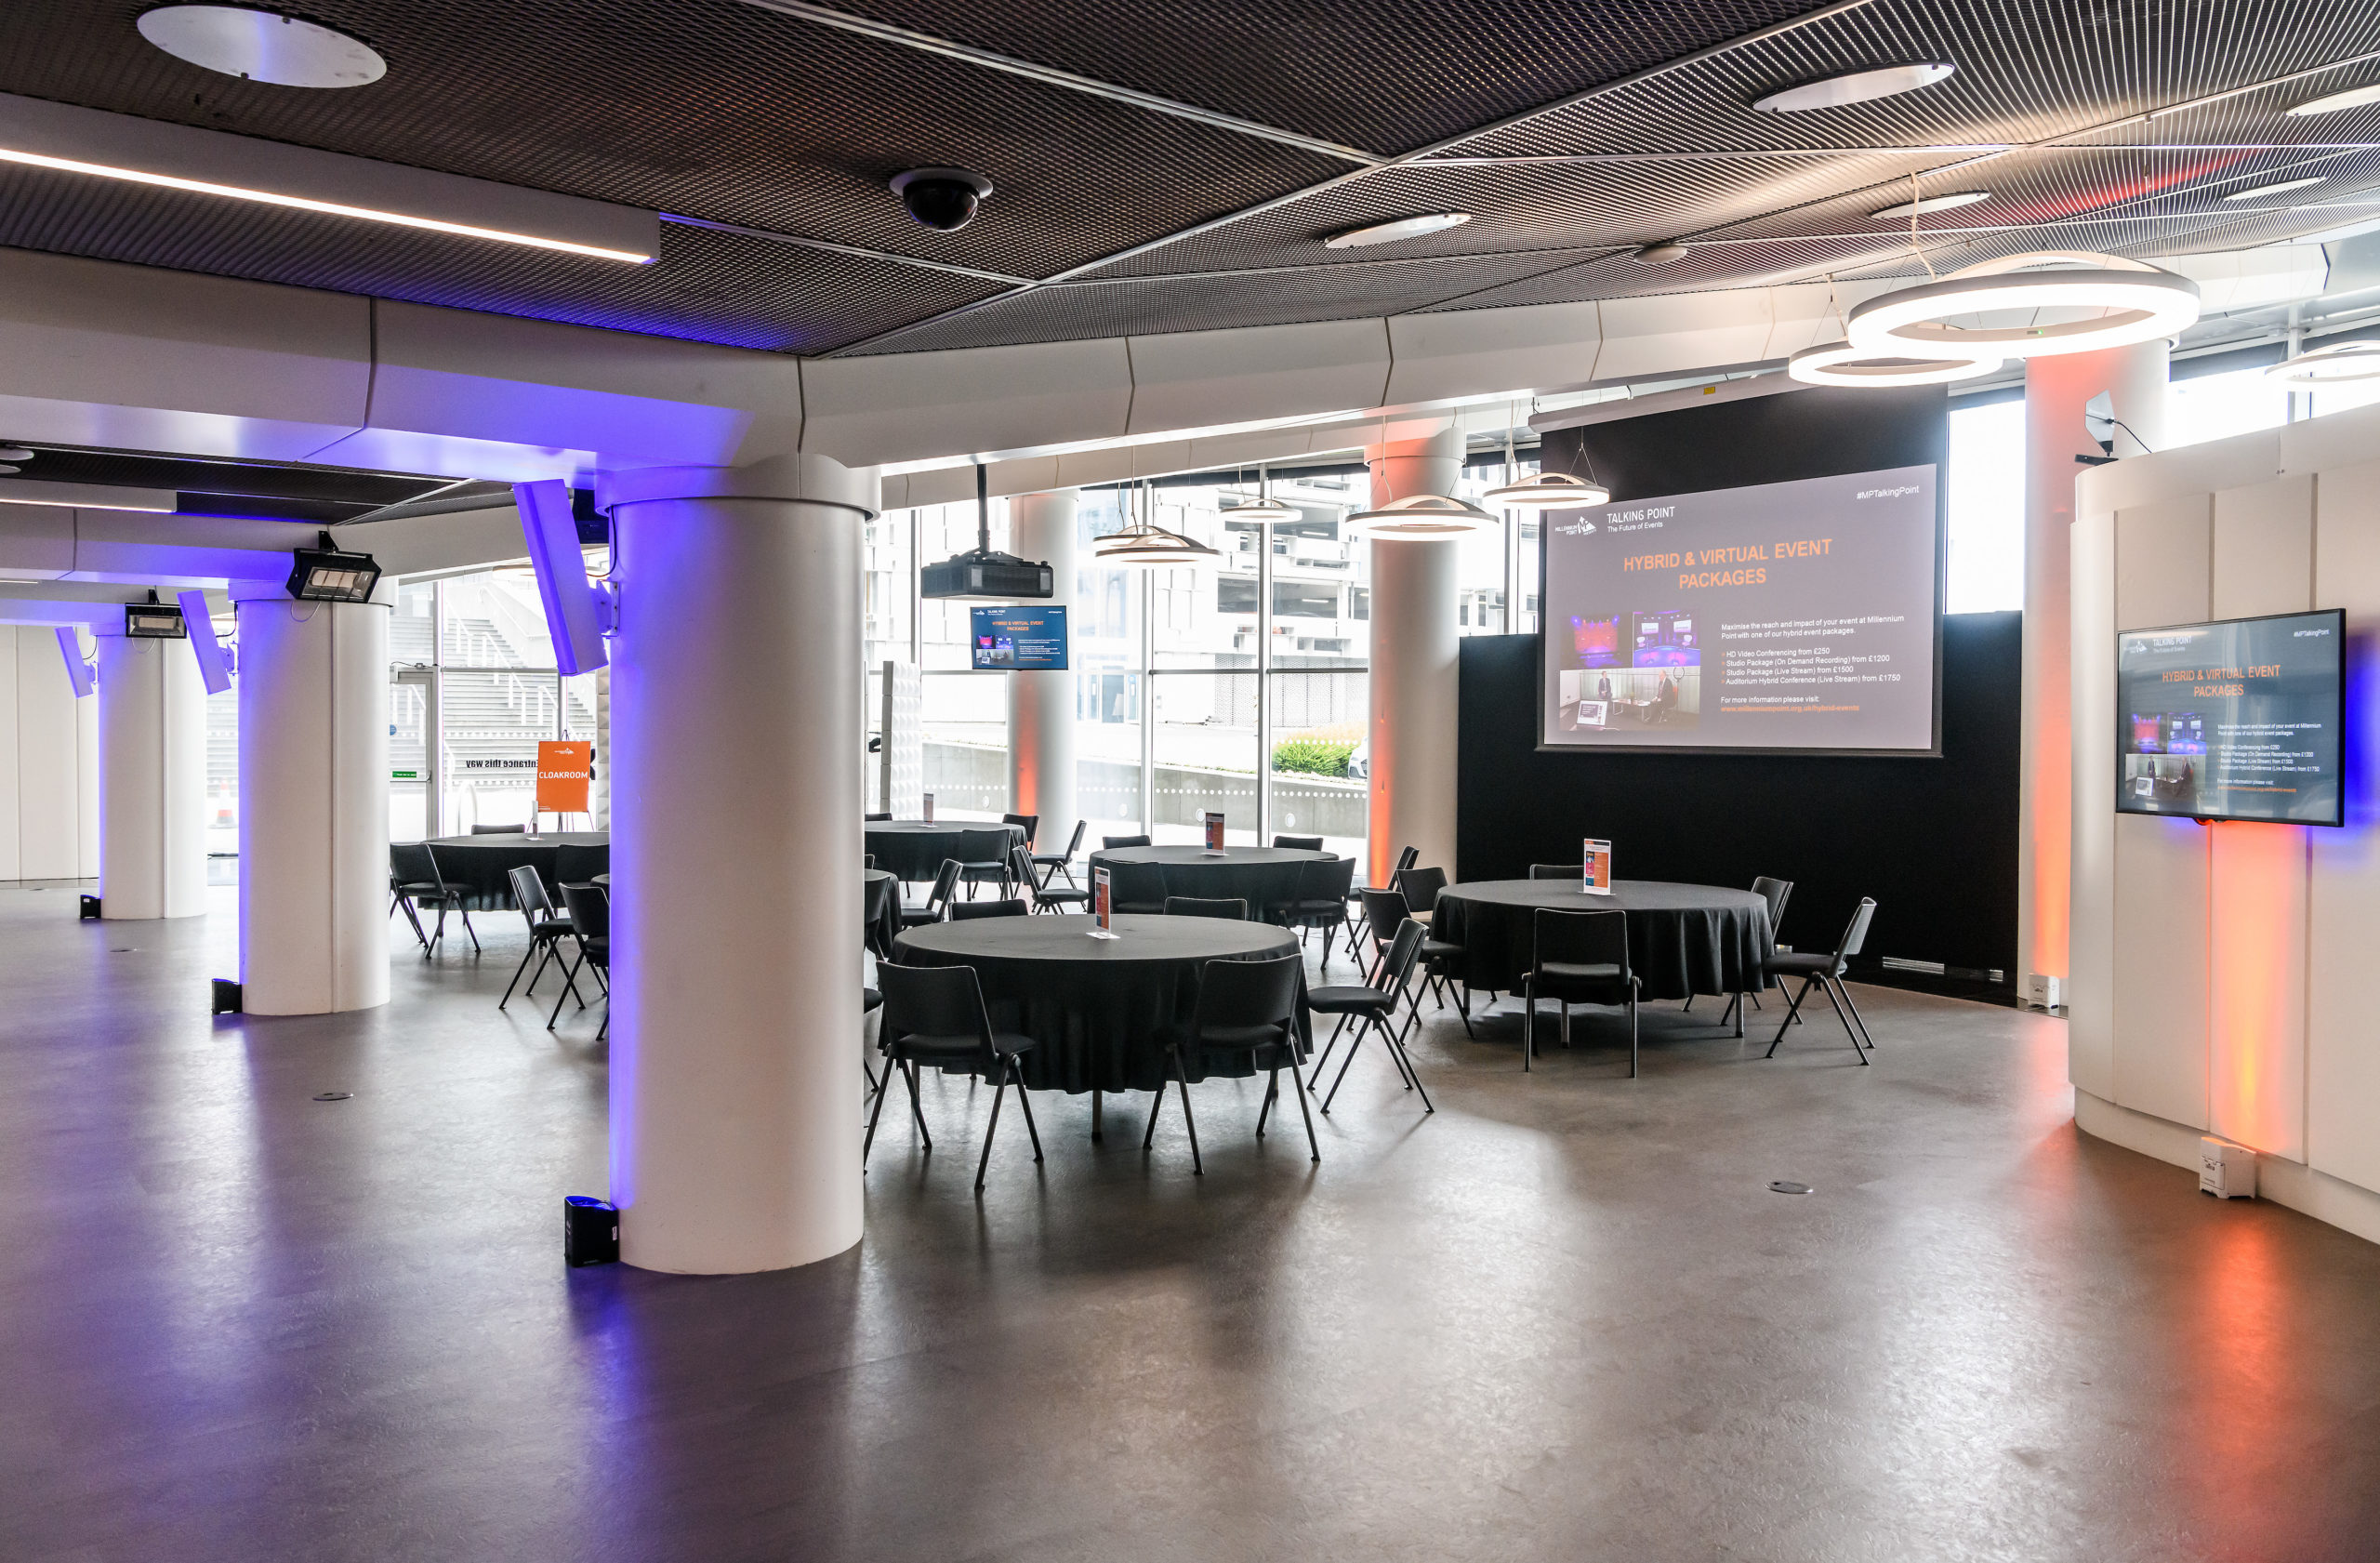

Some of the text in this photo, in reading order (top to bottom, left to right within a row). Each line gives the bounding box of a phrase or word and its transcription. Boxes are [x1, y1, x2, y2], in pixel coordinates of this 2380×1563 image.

[1857, 485, 1920, 499] #MPTalkingPoint
[1606, 506, 1675, 523] TALKING POINT
[1619, 523, 1636, 532] Future
[1645, 521, 1663, 529] Events
[1623, 538, 1832, 572] HYBRID & VIRTUAL EVENT
[1679, 567, 1766, 589] PACKAGES
[1793, 619, 1815, 628] impact
[1823, 618, 1837, 627] your
[1867, 615, 1905, 623] Millennium
[1783, 629, 1803, 638] hybrid
[1822, 627, 1856, 636] packages.
[1747, 658, 1773, 667] Package
[1775, 657, 1786, 666] (On
[1816, 656, 1851, 664] Recording)
[1747, 669, 1773, 677] Package
[1775, 668, 1790, 676] (Live
[1791, 667, 1816, 675] Stream)
[2162, 665, 2281, 682] HYBRID & VIRTUAL EVENT
[1759, 677, 1778, 685] Hybrid
[1780, 676, 1816, 684] Conference
[1818, 676, 1833, 684] (Live
[1834, 675, 1860, 683] Stream)
[1878, 673, 1901, 682] £1750
[2194, 683, 2244, 697] PACKAGES
[1783, 695, 1804, 704] please
[538, 771, 588, 779] CLOAKROOM
